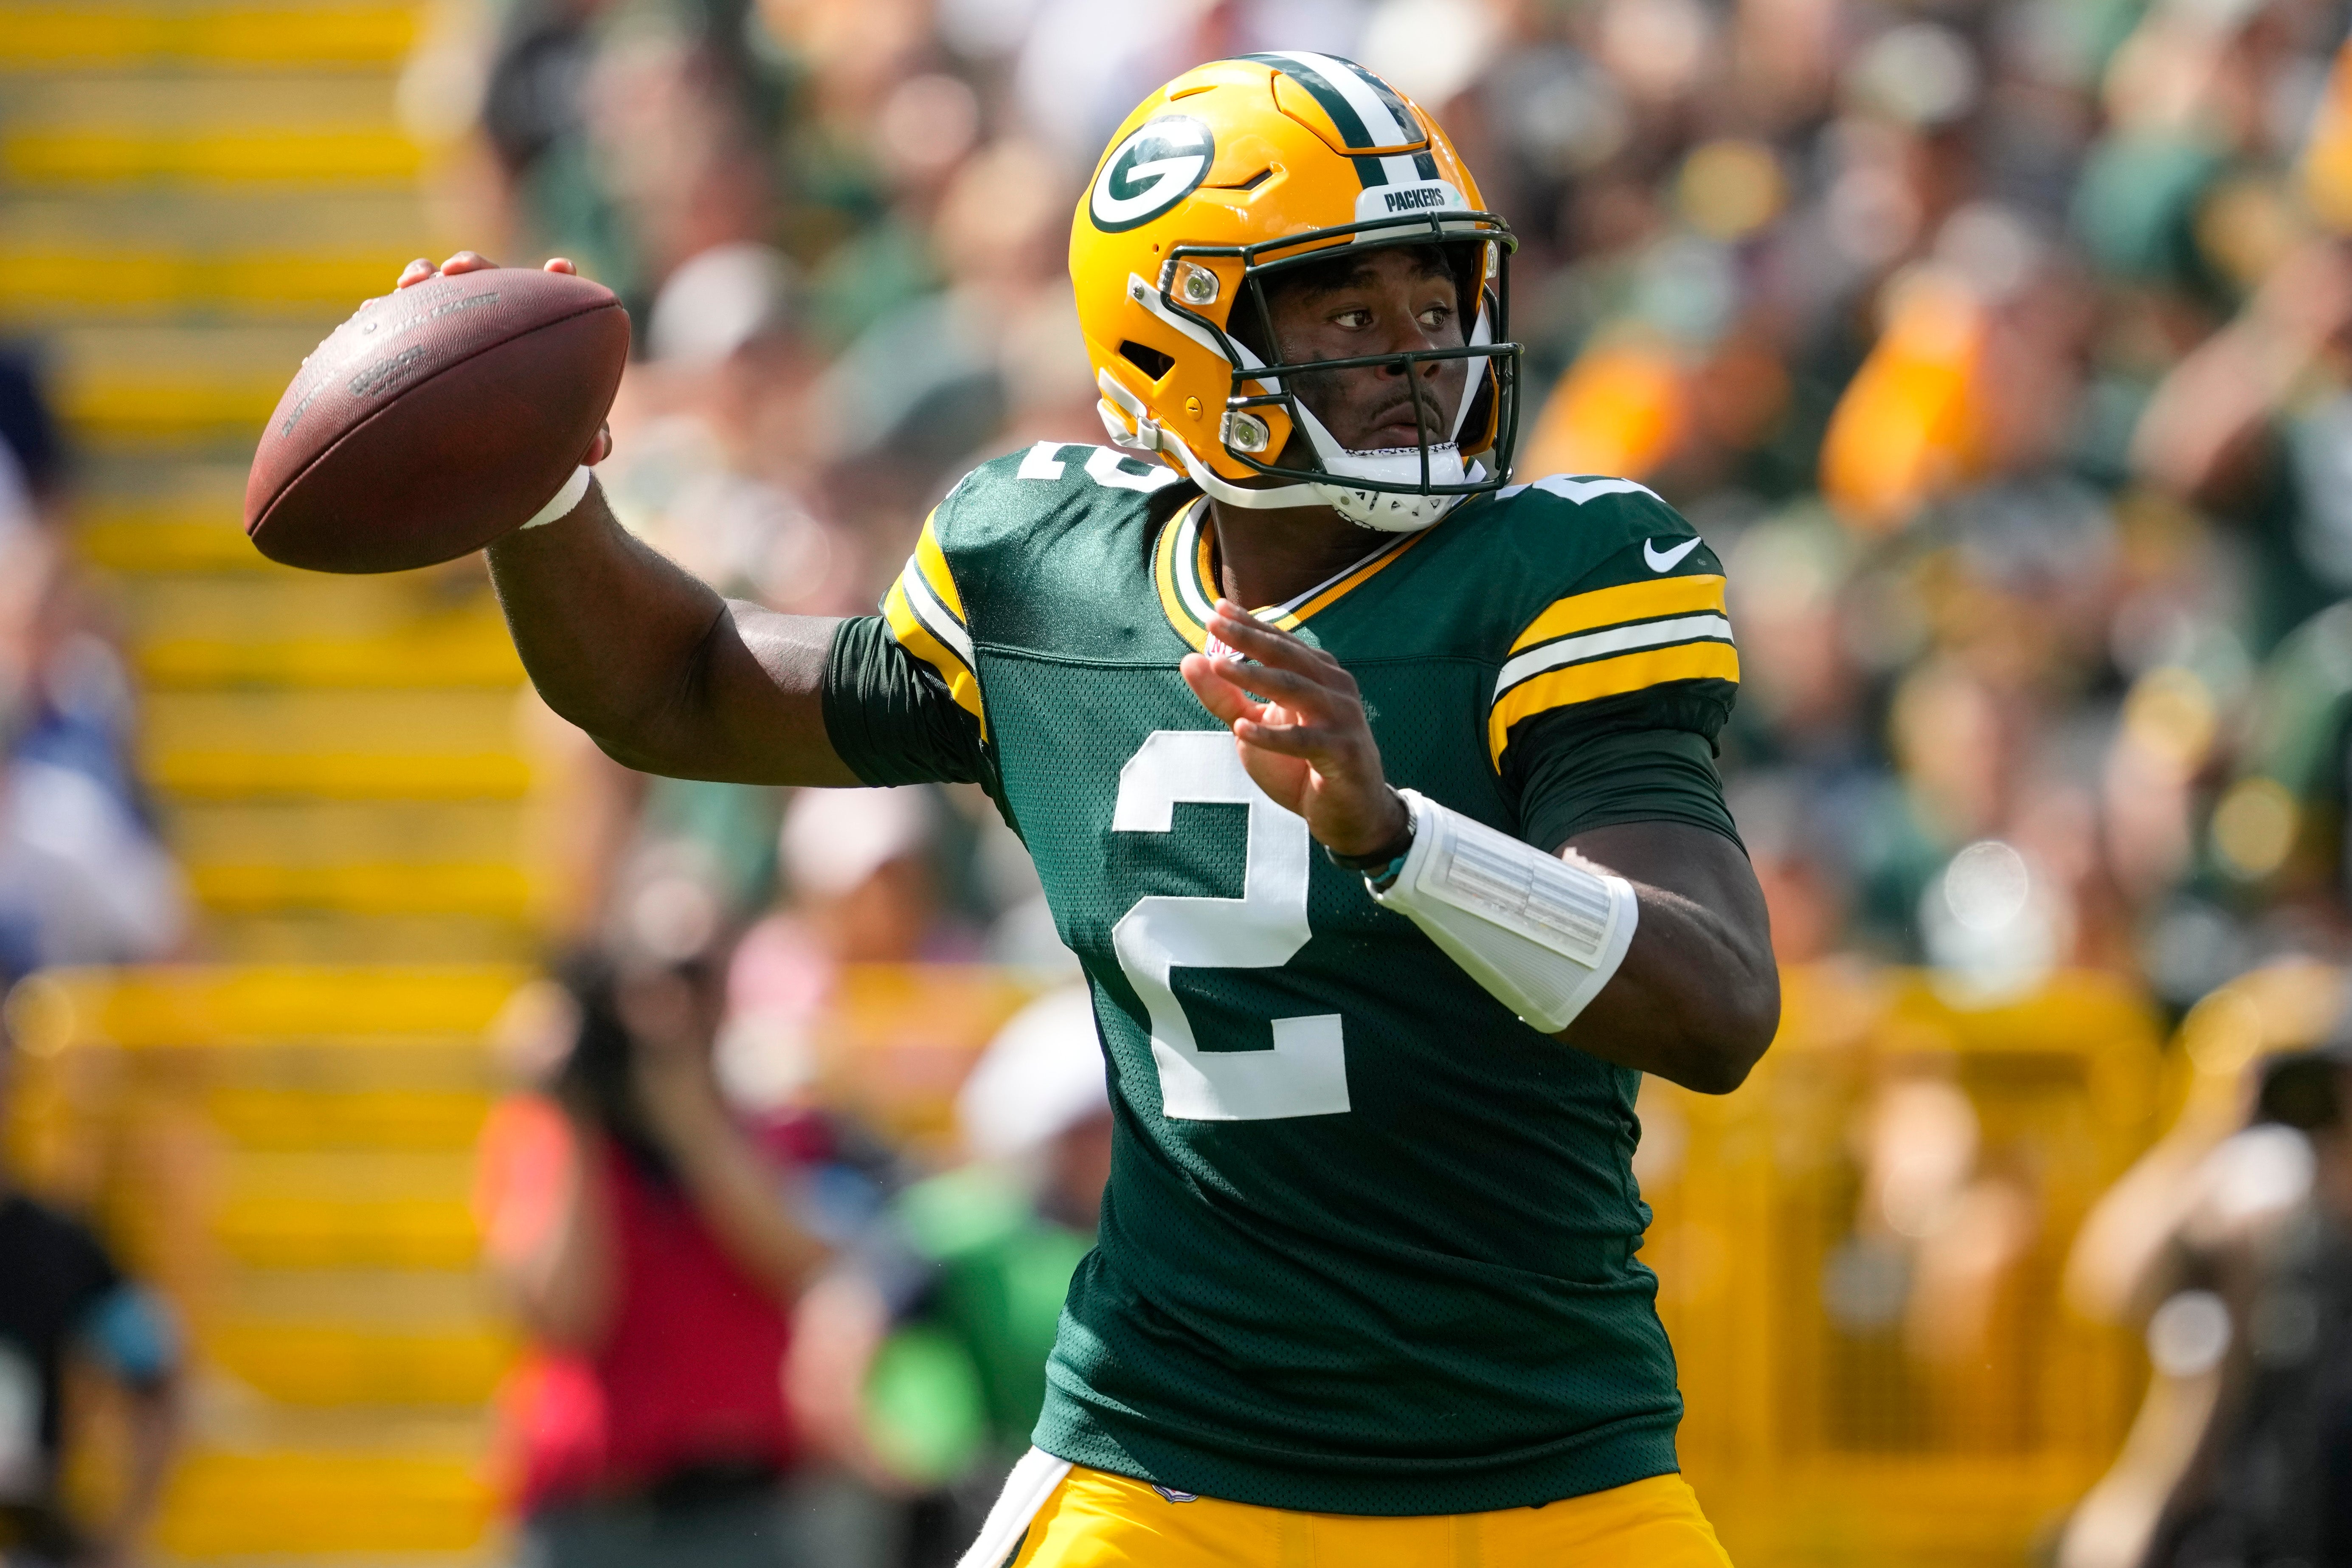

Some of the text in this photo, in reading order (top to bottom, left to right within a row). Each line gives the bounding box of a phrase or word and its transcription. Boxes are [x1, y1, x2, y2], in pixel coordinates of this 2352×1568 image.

[1092, 121, 1206, 223] G
[1384, 188, 1445, 212] PACKERS
[1112, 730, 1351, 1120] 2
